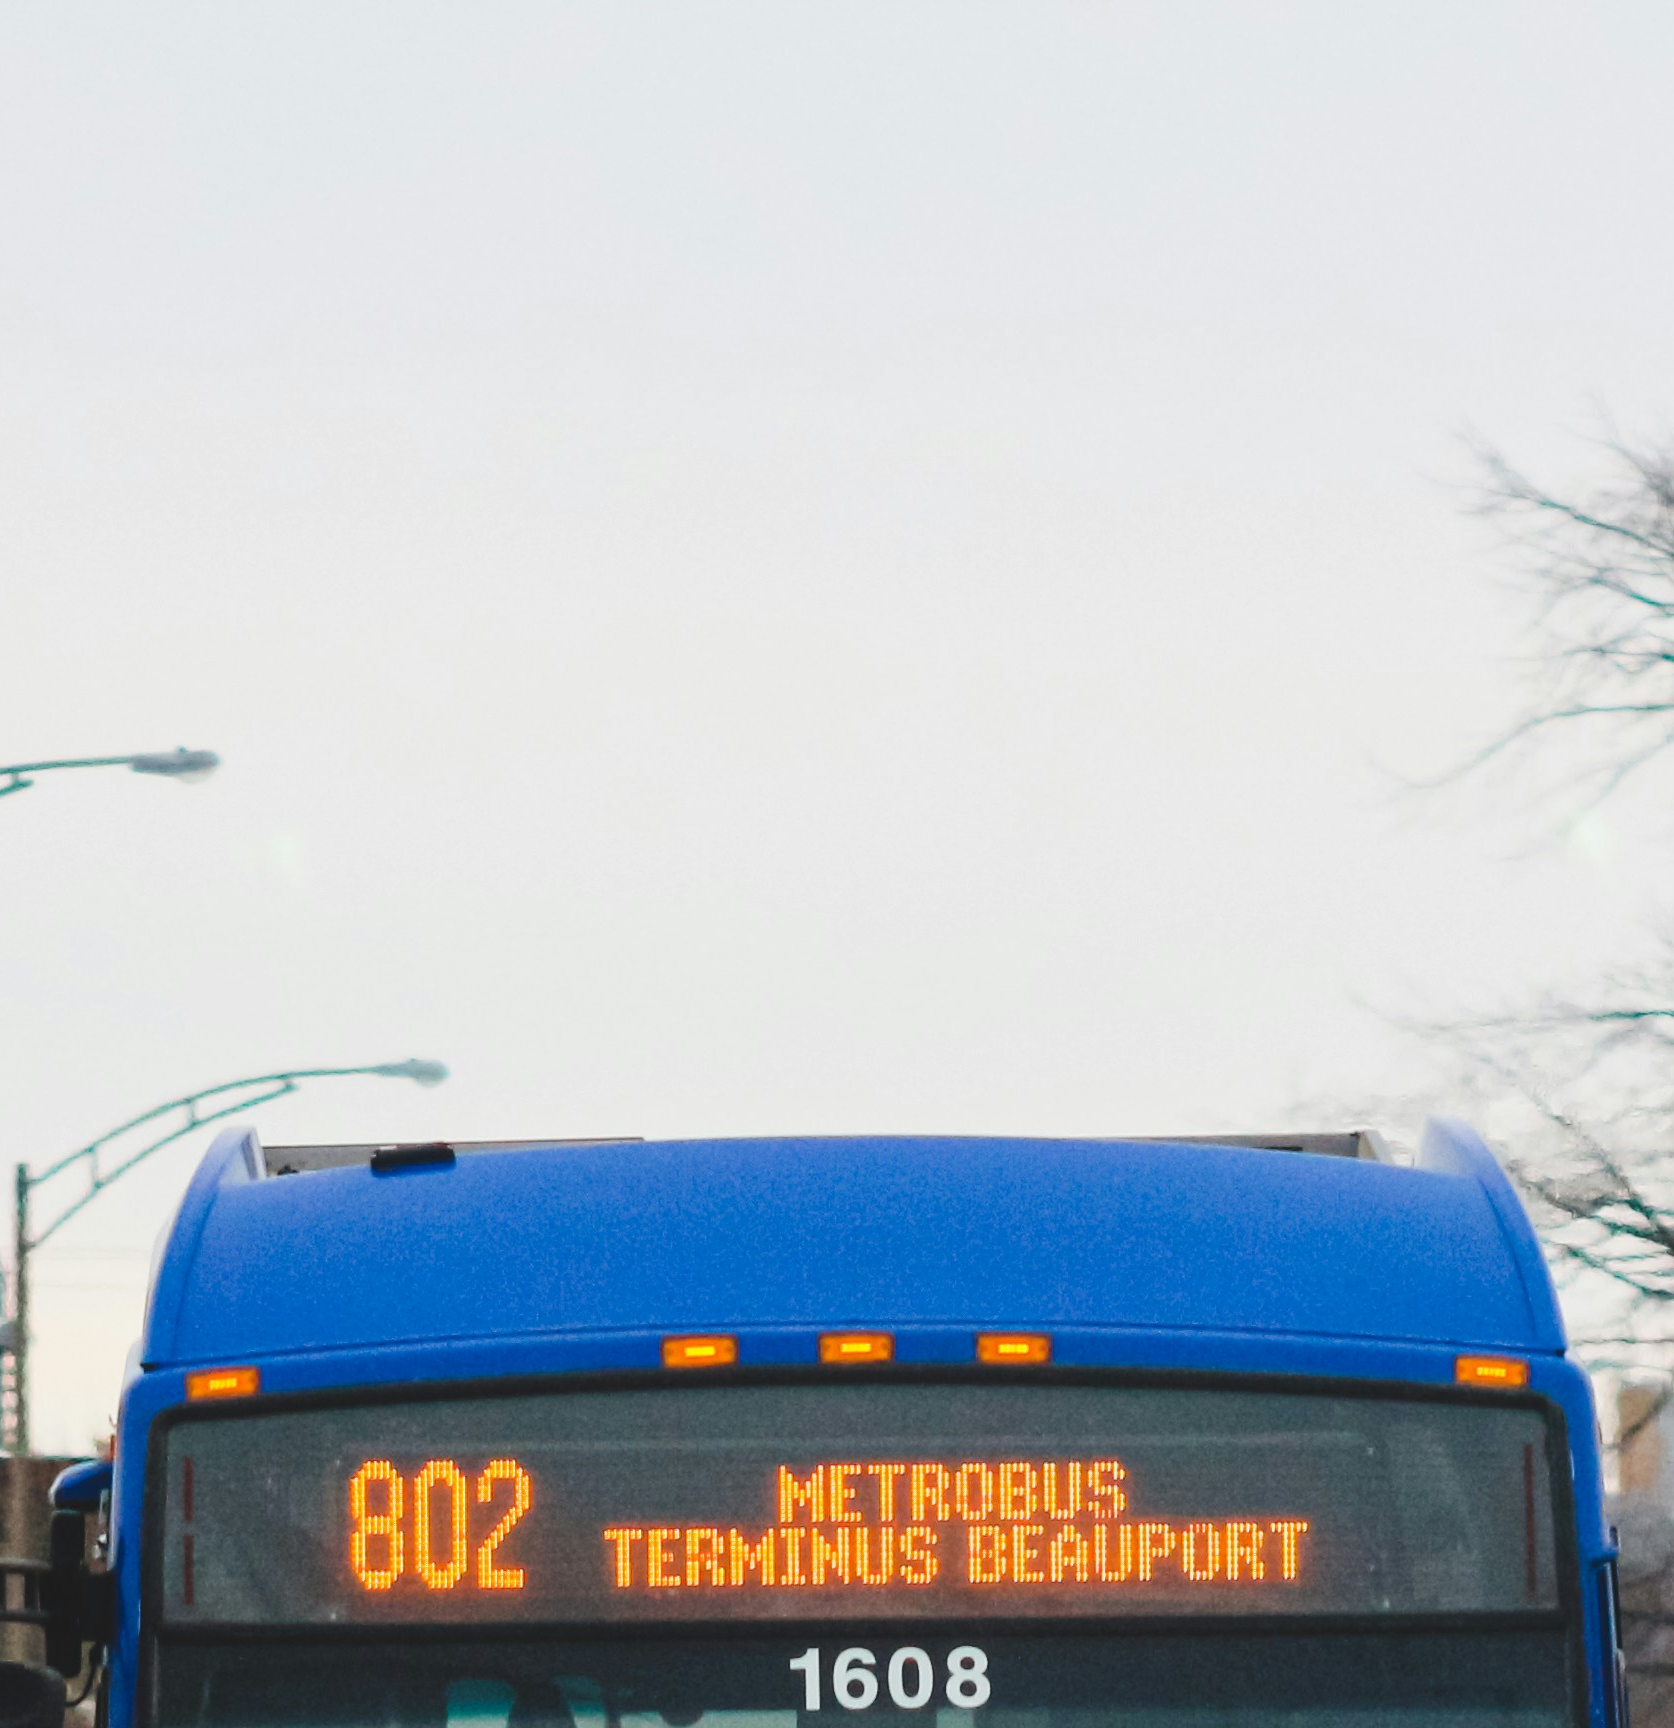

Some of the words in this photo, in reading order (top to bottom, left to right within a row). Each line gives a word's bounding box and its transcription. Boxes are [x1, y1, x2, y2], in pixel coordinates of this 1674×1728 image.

[348, 1457, 531, 1590] 802
[775, 1458, 1129, 1523] METROBUS
[603, 1521, 941, 1590] TERMINUS
[966, 1519, 1309, 1586] BEAUPORT
[788, 1645, 992, 1711] 1608
